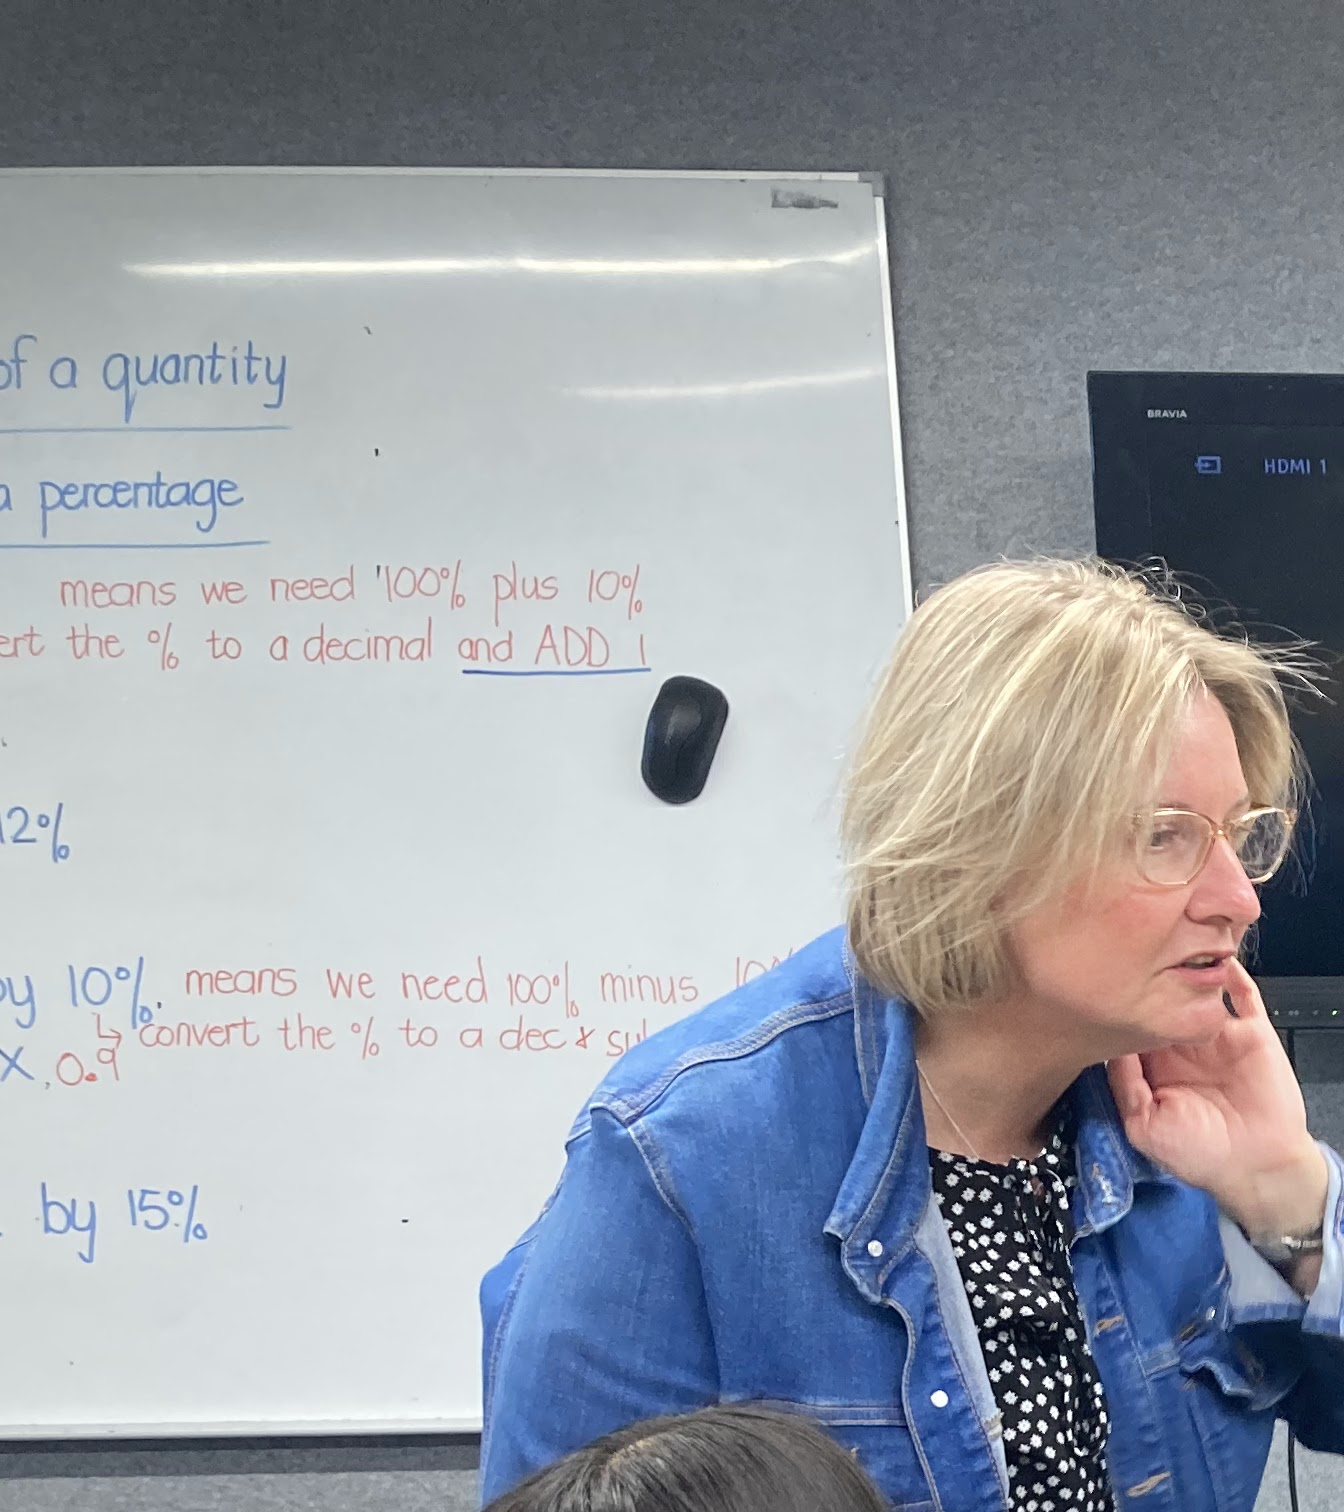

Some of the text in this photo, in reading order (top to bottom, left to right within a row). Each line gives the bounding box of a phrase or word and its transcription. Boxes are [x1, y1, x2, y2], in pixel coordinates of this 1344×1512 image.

[50, 357, 77, 389] a
[103, 340, 287, 424] quantity
[1147, 409, 1188, 419] BRAVIA
[1265, 458, 1328, 475] HDMI 1
[39, 471, 245, 539] percentage
[60, 579, 177, 608] means
[200, 580, 247, 605] we
[270, 565, 355, 602] need
[493, 561, 559, 628] plus
[587, 564, 643, 621] 10%
[66, 623, 125, 658] the
[147, 622, 179, 671] %
[206, 629, 241, 660] to
[270, 634, 289, 662] a
[303, 617, 433, 663] decimal
[458, 631, 513, 662] and
[535, 624, 610, 667] ADD
[0, 956, 153, 1030] y 10%
[185, 967, 298, 997] means
[326, 968, 377, 999] we
[401, 956, 488, 1003] need
[507, 961, 580, 1018] 100%
[600, 970, 700, 1005] minus
[139, 1014, 260, 1050] convert
[277, 1013, 336, 1050] the
[351, 1016, 380, 1060] %
[400, 1018, 438, 1049] to
[459, 1030, 483, 1049] a
[499, 1016, 567, 1051] dec
[41, 1182, 208, 1264] by 15%
